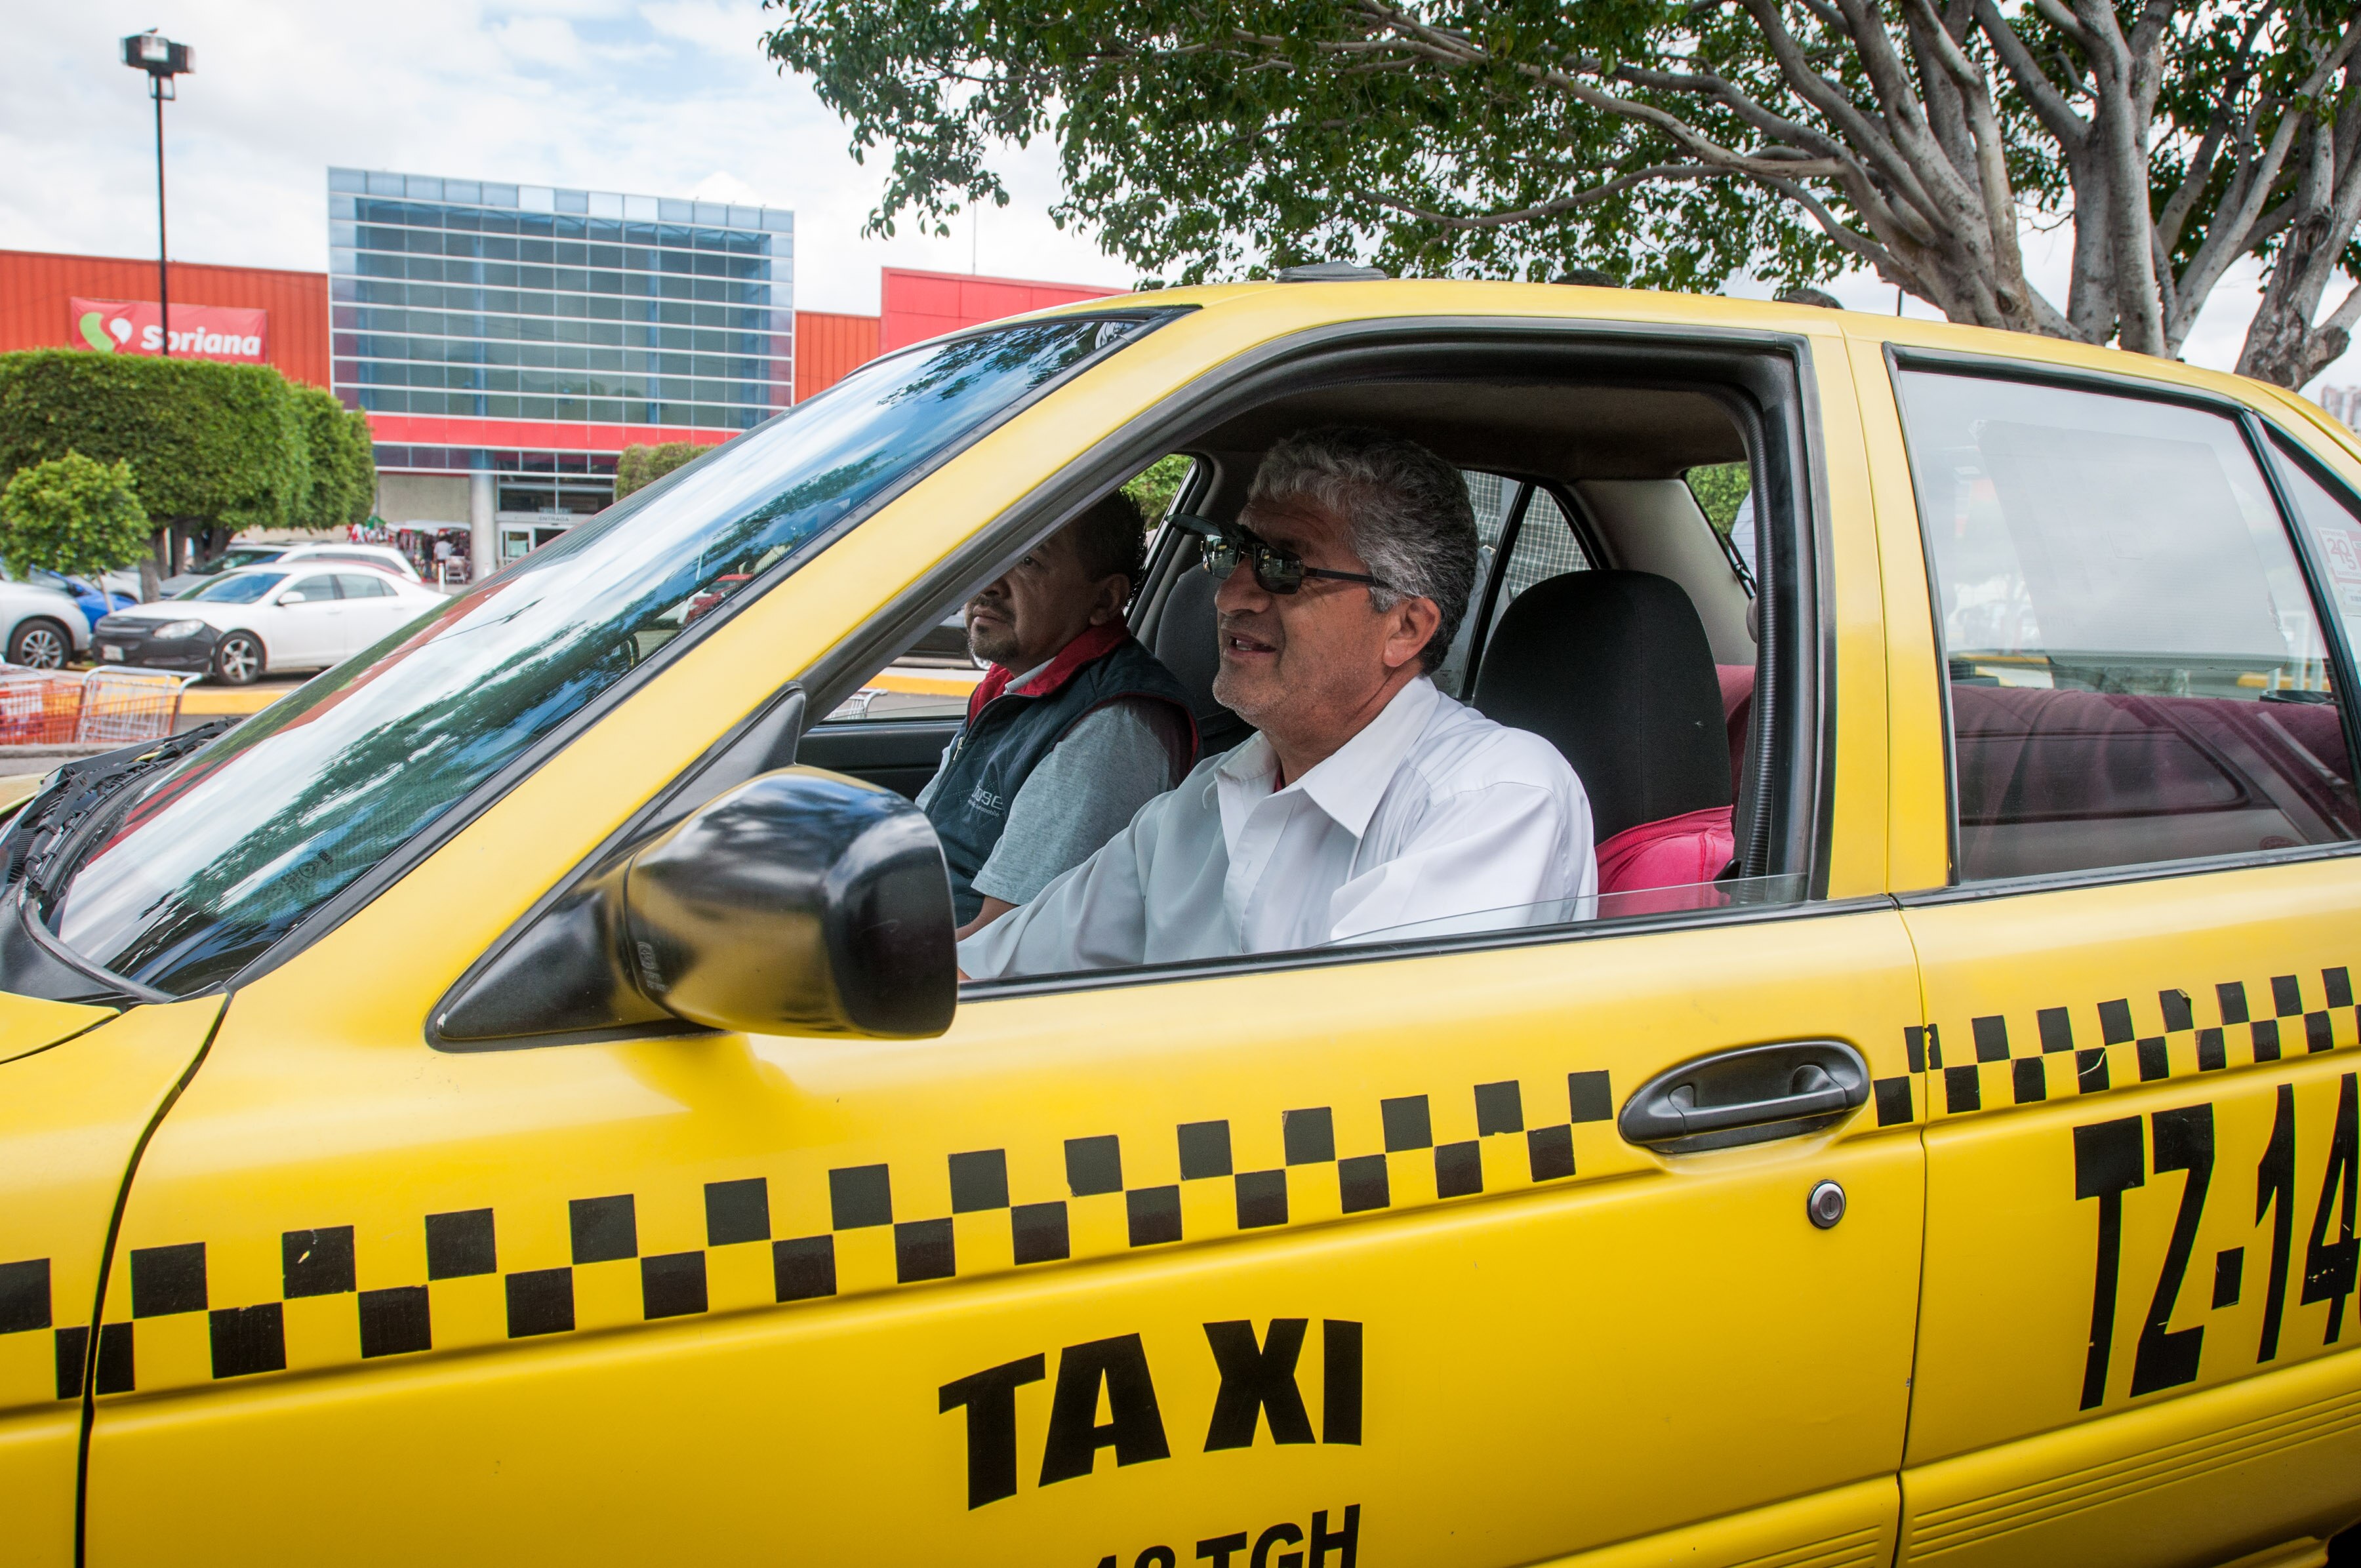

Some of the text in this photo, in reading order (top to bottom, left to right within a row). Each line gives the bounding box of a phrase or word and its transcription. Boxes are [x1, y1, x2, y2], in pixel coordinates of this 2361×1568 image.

[140, 324, 261, 356] Soriana
[2073, 1072, 2361, 1411] TZ-14
[938, 1317, 1363, 1511] TAXI
